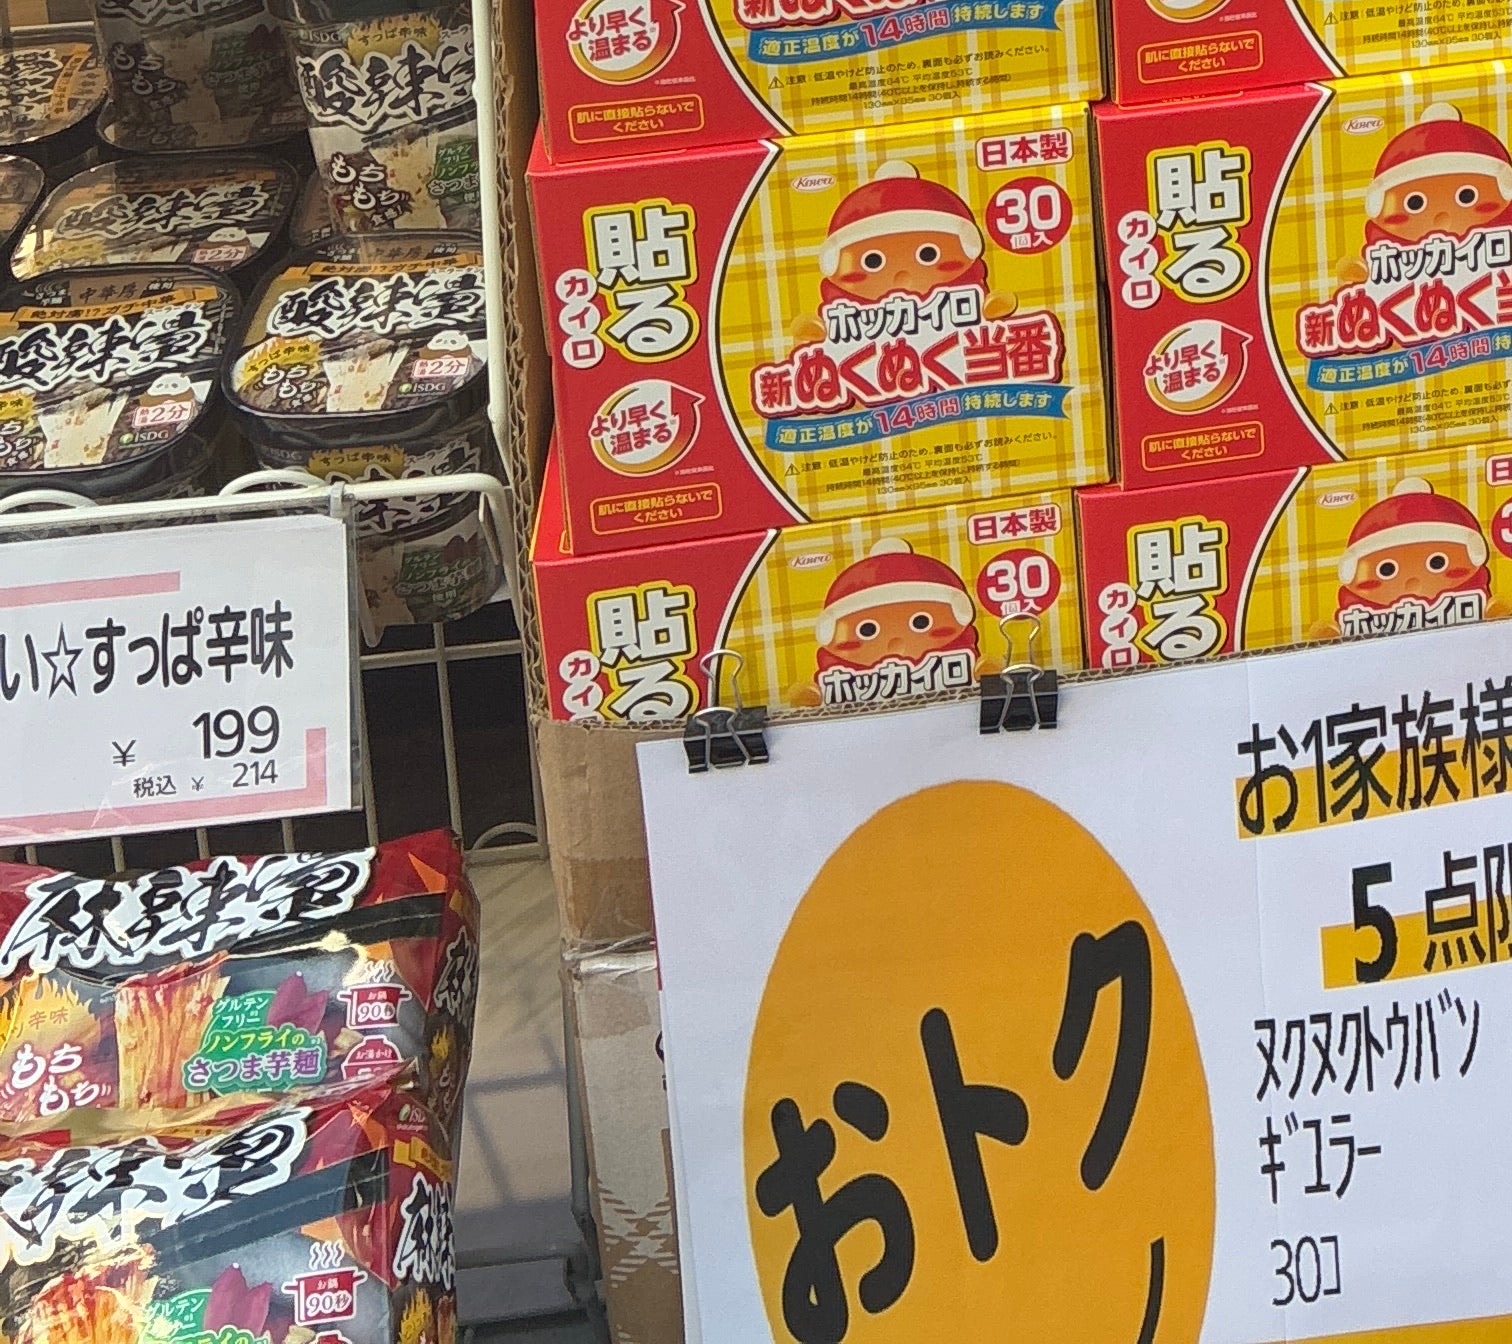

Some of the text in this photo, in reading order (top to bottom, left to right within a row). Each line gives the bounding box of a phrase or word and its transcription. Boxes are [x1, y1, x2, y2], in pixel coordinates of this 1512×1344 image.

[567, 8, 648, 44] より早く
[586, 28, 654, 62] 温まる
[574, 100, 696, 126] 肌に直接貼らないで
[613, 116, 667, 135] ください
[112, 706, 280, 766] ¥ 199
[132, 775, 177, 798] 税込
[231, 759, 279, 788] 214
[1353, 864, 1399, 983] 5
[207, 1028, 305, 1053] ノンフライの
[187, 1048, 323, 1087] さつま芋麺
[756, 919, 1154, 1344] おトク
